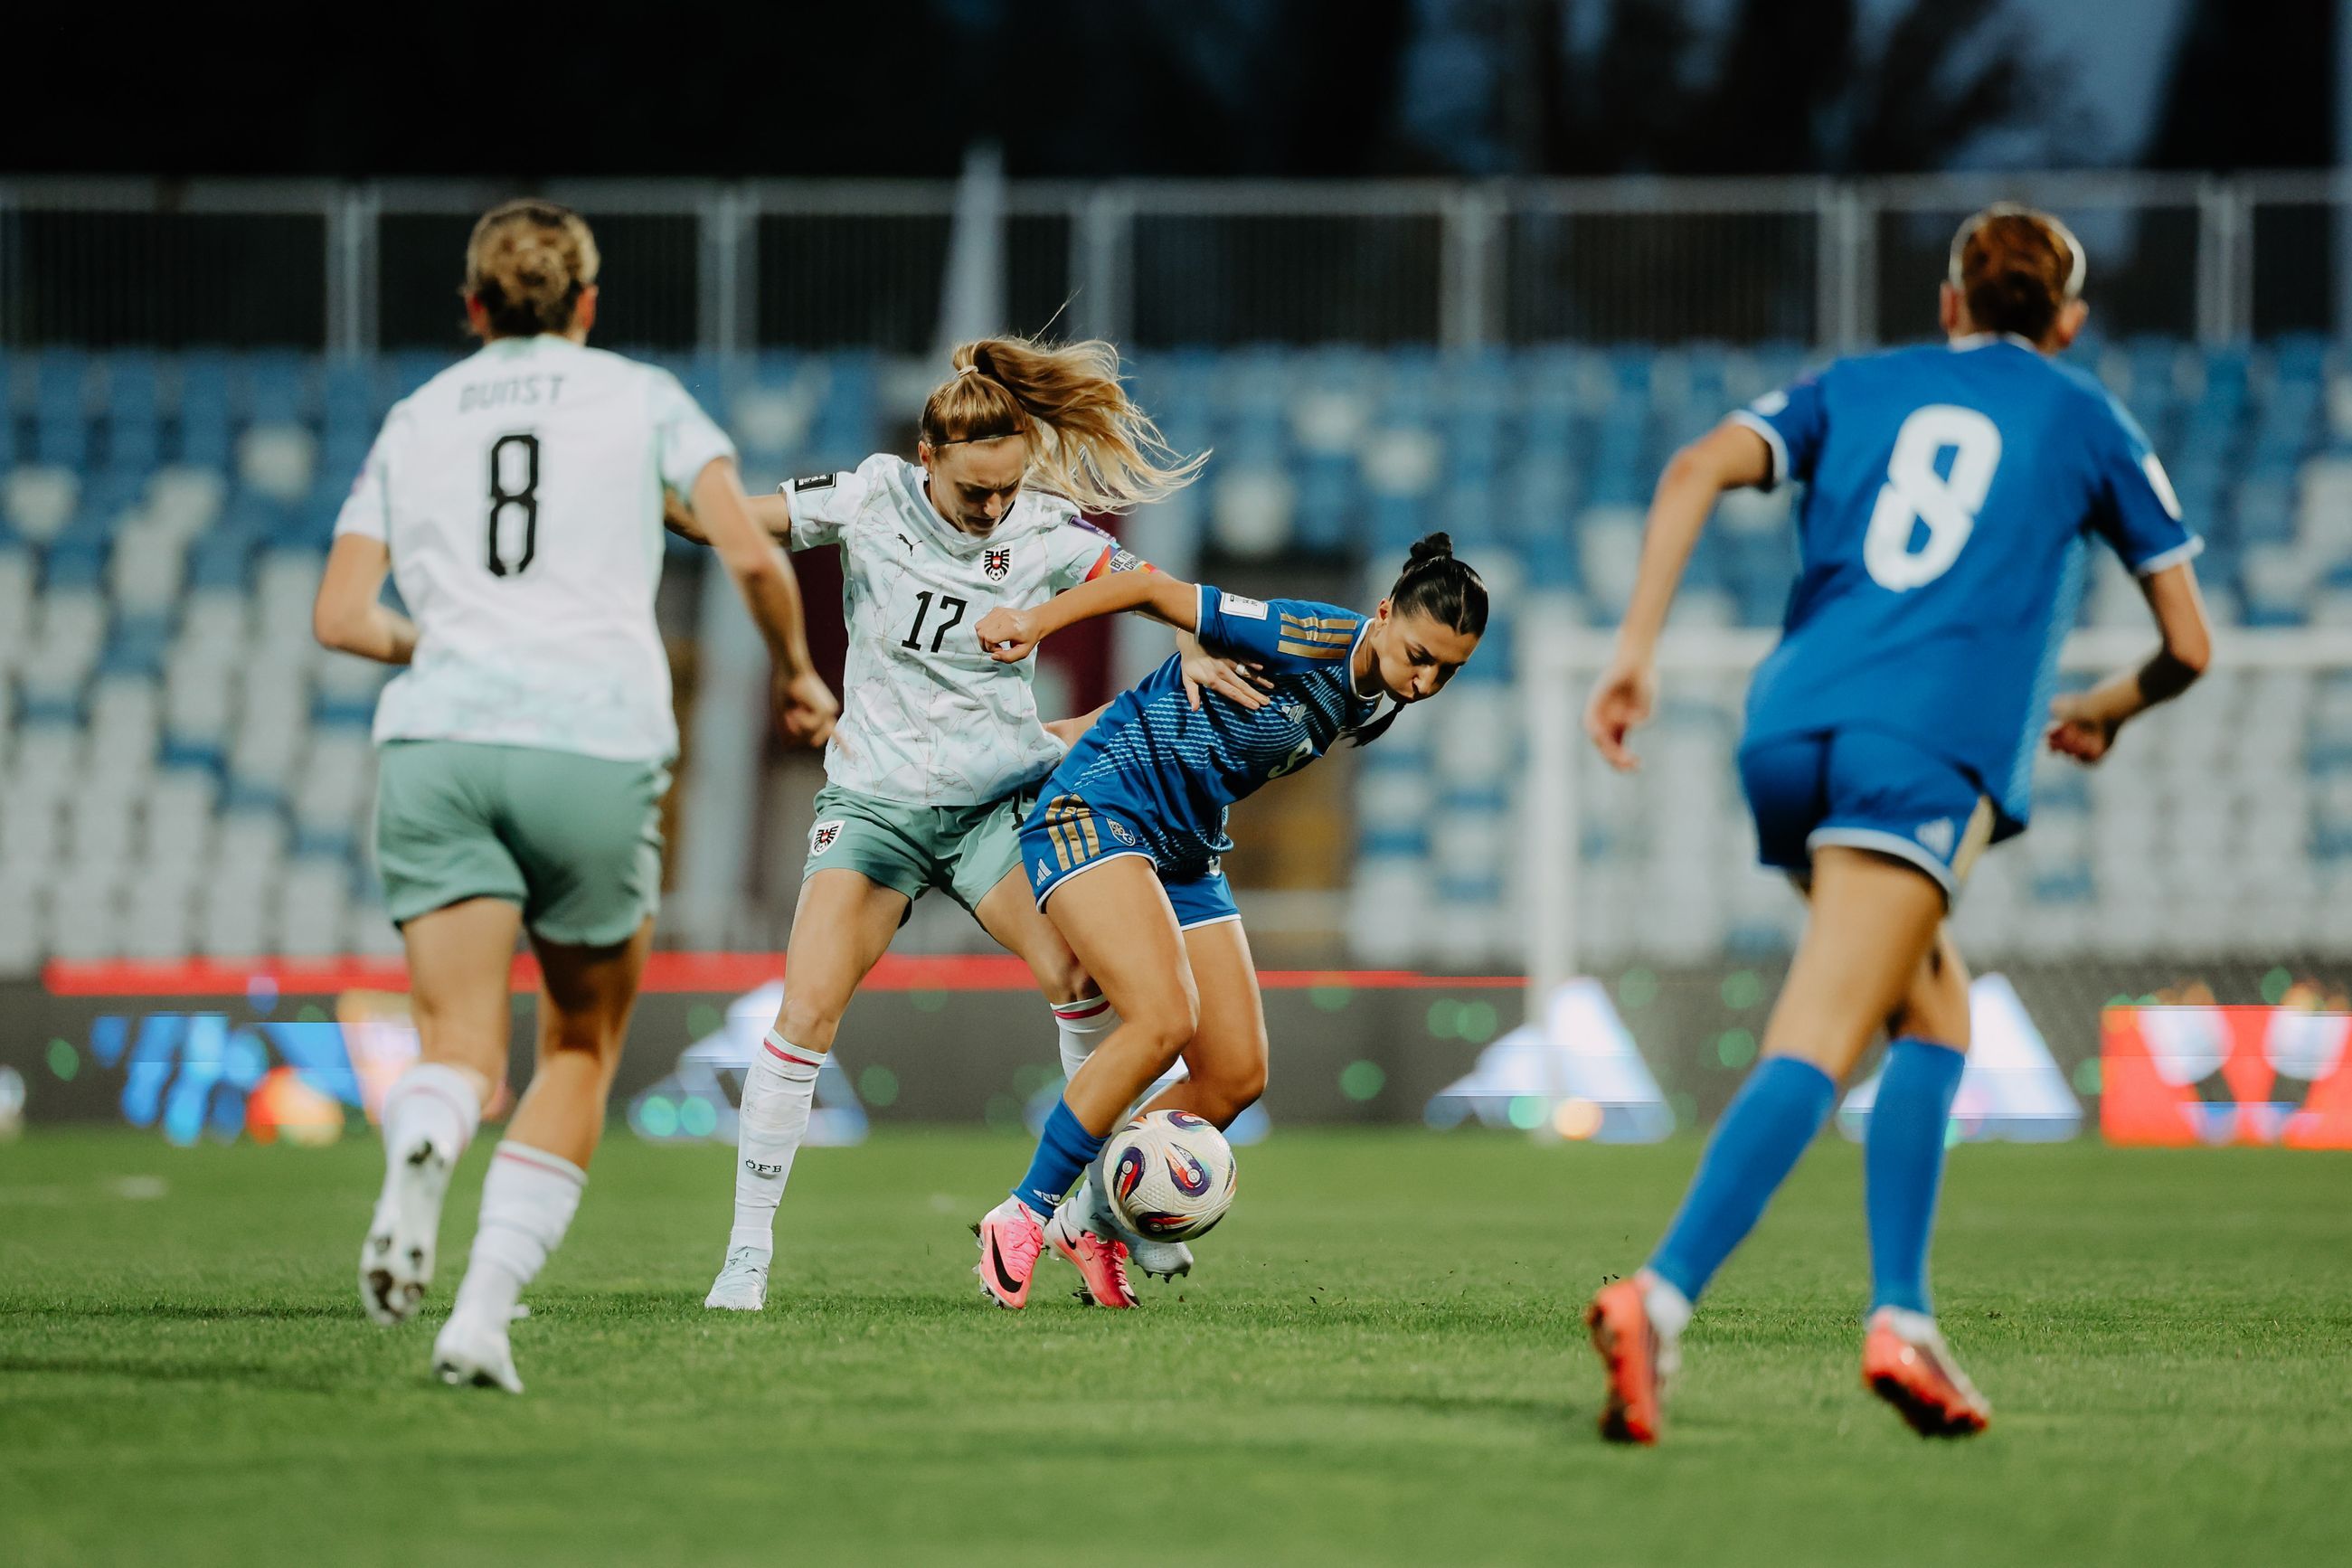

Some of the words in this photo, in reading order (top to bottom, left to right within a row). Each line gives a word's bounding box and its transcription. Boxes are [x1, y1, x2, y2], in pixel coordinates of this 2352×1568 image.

[458, 374, 567, 412] DUNST
[488, 432, 539, 578] 8
[1864, 404, 2002, 592] 8
[1110, 557, 1124, 570] BE
[901, 590, 968, 653] 17
[745, 1158, 782, 1173] ÖFB
